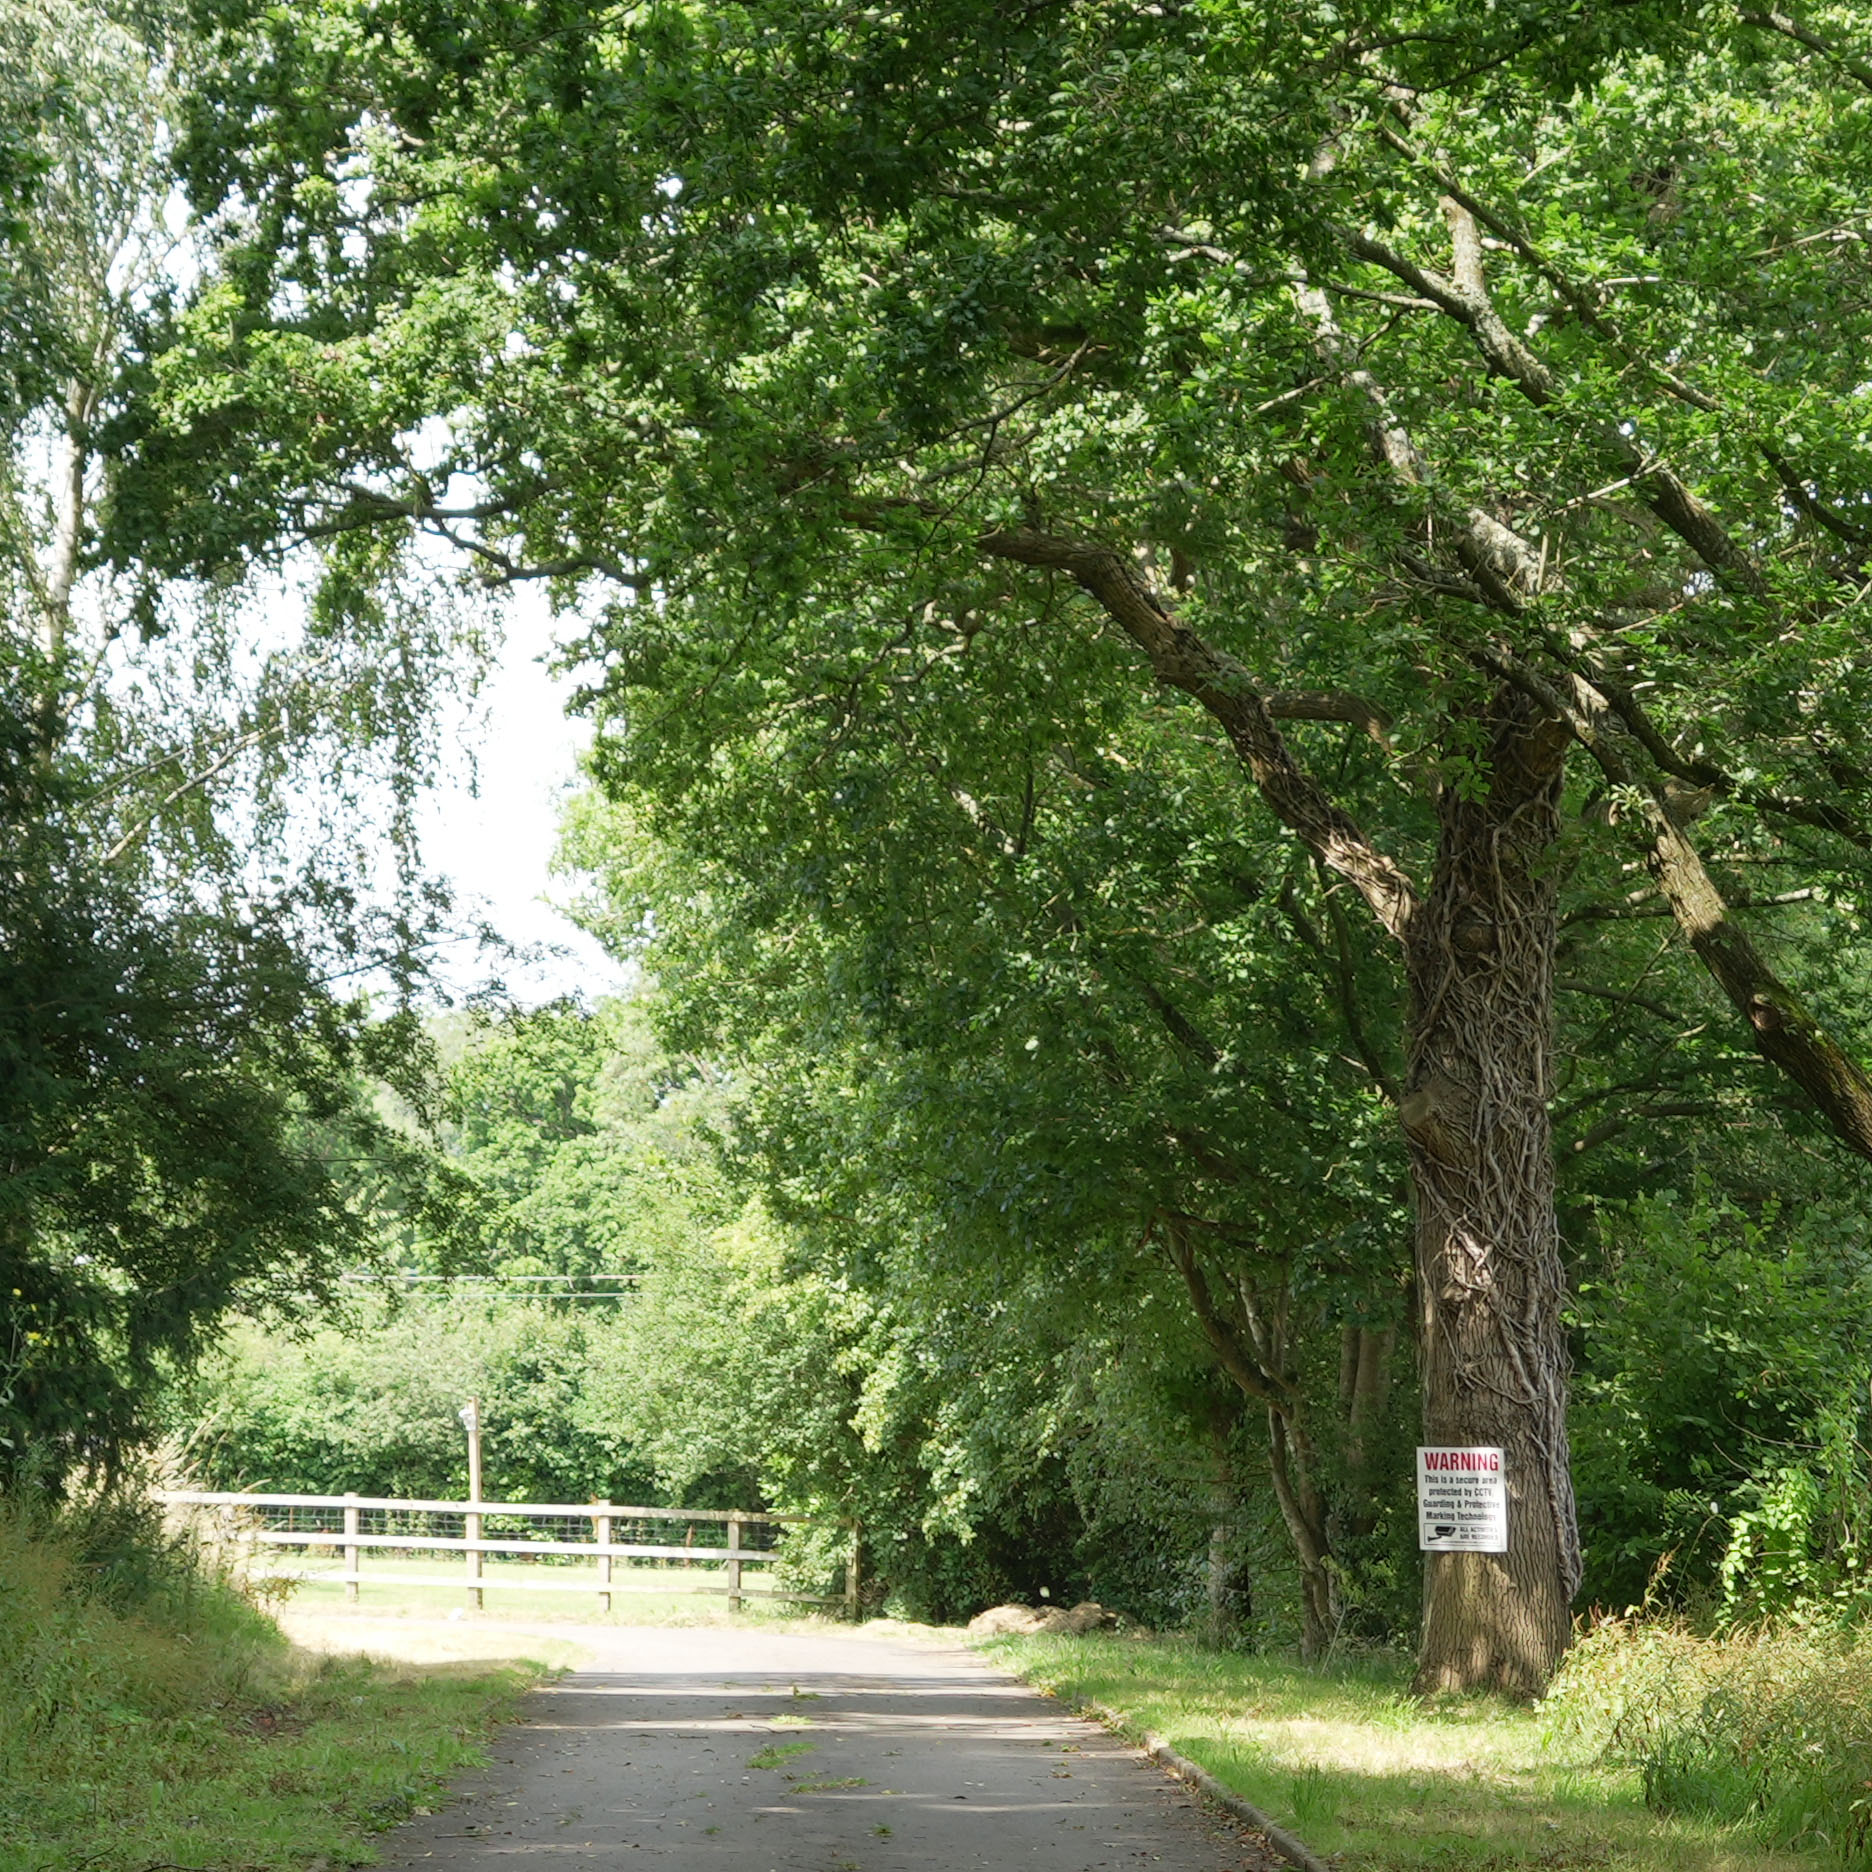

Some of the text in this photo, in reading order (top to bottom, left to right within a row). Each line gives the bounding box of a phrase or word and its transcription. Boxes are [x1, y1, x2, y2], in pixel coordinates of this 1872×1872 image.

[1424, 1452, 1499, 1471] WARNING
[1424, 1475, 1439, 1484] This
[1441, 1475, 1447, 1484] is
[1449, 1476, 1454, 1484] a
[1456, 1476, 1479, 1484] secure
[1429, 1488, 1462, 1496] protected
[1464, 1488, 1473, 1497] by
[1426, 1512, 1455, 1521] Marking
